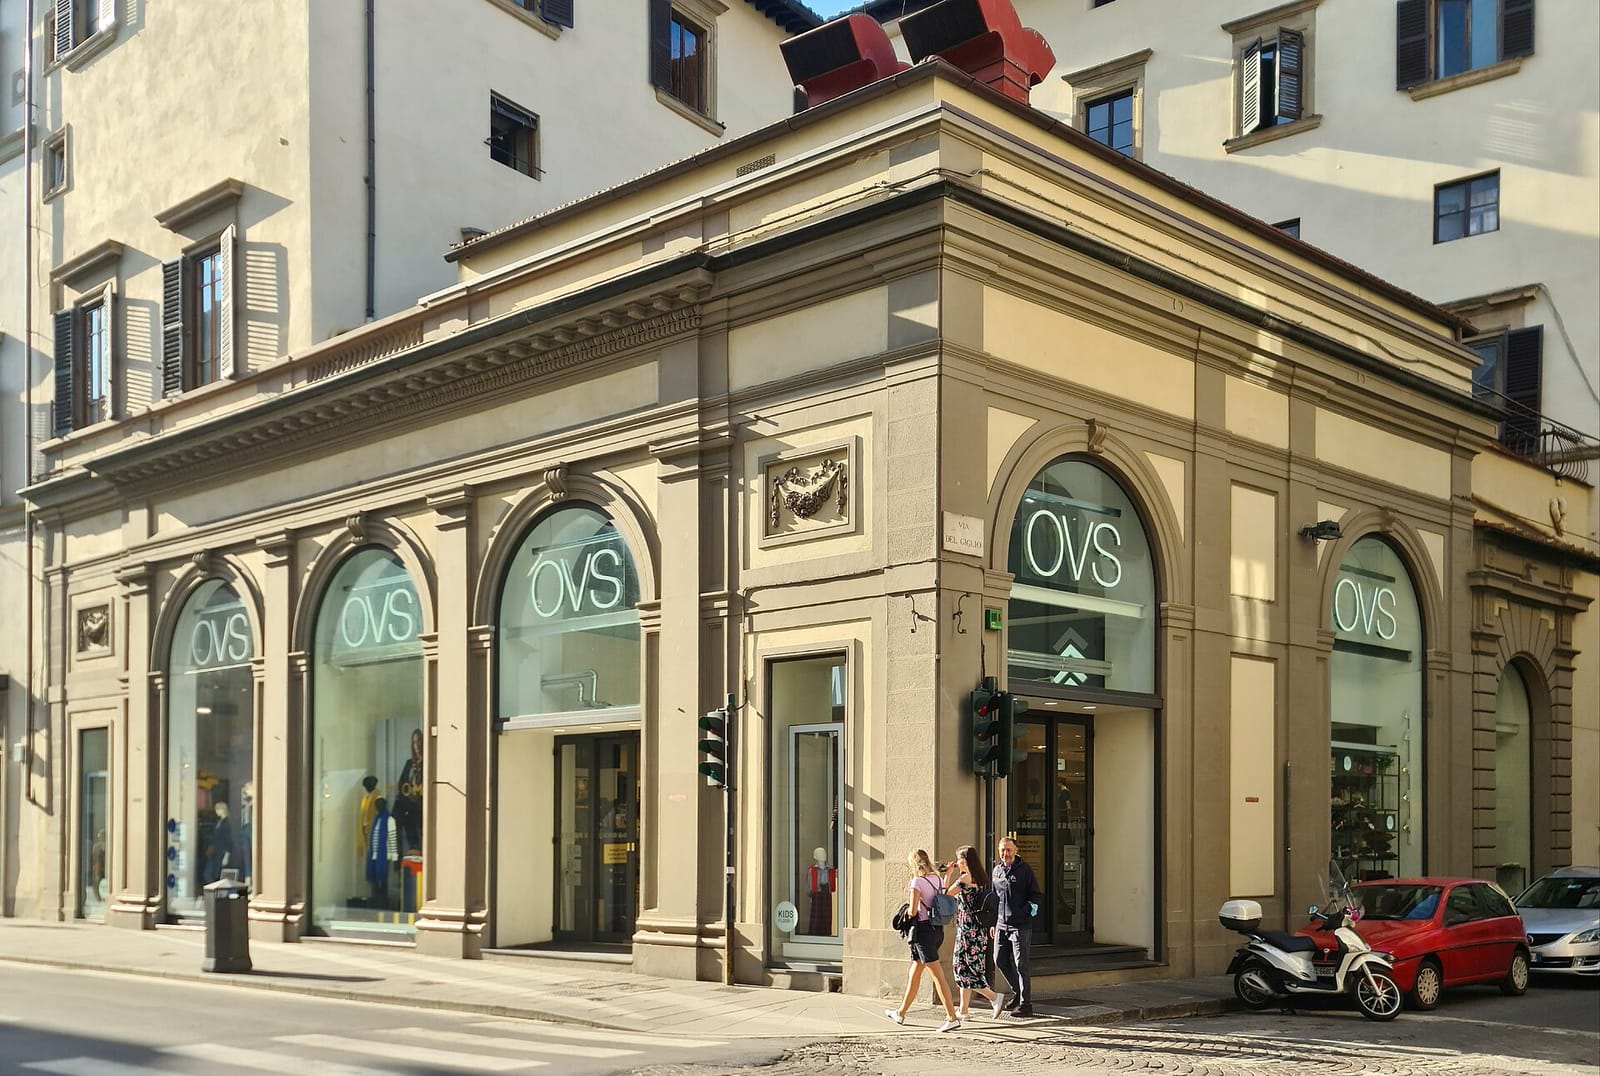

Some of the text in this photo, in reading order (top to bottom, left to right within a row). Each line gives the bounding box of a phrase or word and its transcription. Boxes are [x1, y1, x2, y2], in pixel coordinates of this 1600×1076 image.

[945, 535, 982, 549] DEL GIGLIO
[958, 521, 969, 530] VIA
[1027, 509, 1122, 587] OVS
[531, 549, 622, 618] OVS
[1334, 578, 1397, 640] OVS
[191, 613, 249, 666] OVS
[341, 588, 413, 648] OVS
[778, 910, 793, 918] KIDS
